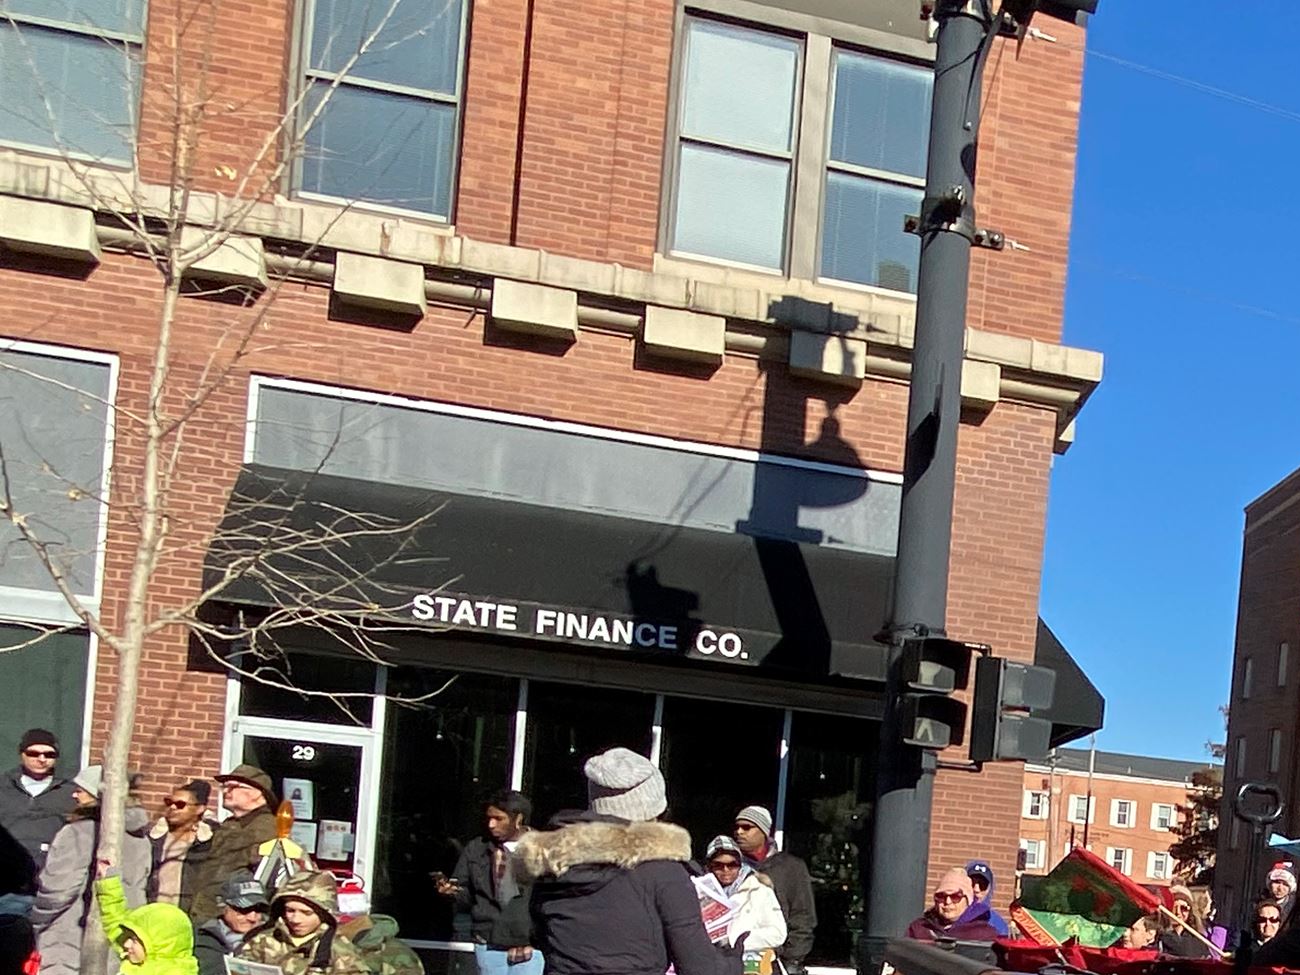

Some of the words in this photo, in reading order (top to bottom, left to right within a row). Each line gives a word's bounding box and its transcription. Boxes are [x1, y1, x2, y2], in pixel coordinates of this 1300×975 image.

[412, 594, 518, 630] STATE
[536, 609, 678, 650] FINANCE
[695, 629, 749, 660] CO.
[292, 745, 315, 760] 29
